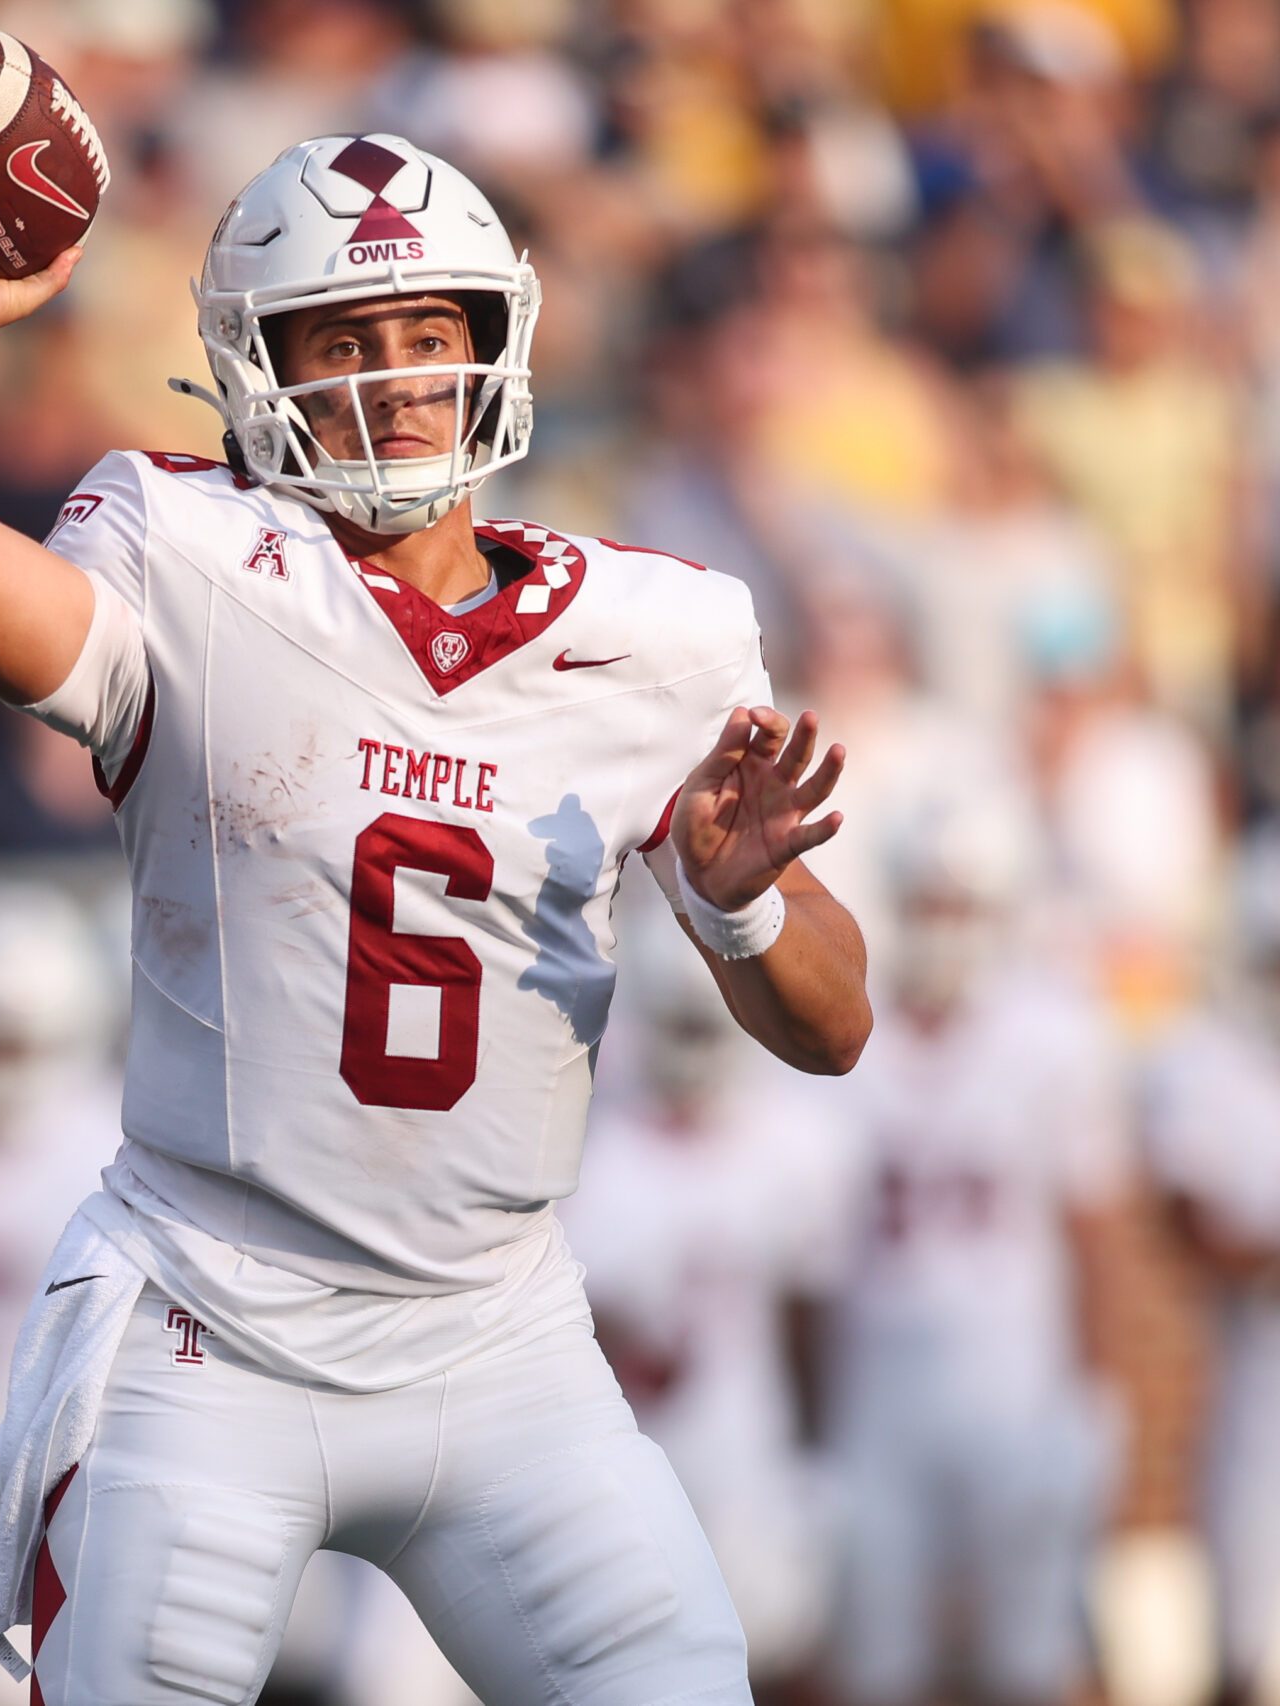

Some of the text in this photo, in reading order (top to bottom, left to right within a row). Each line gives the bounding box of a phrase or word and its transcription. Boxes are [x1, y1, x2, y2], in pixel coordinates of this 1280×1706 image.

[347, 240, 425, 266] OWLS
[243, 527, 290, 582] A
[357, 737, 499, 813] TEMPLE
[338, 811, 496, 1112] 6
[162, 1303, 217, 1369] T
